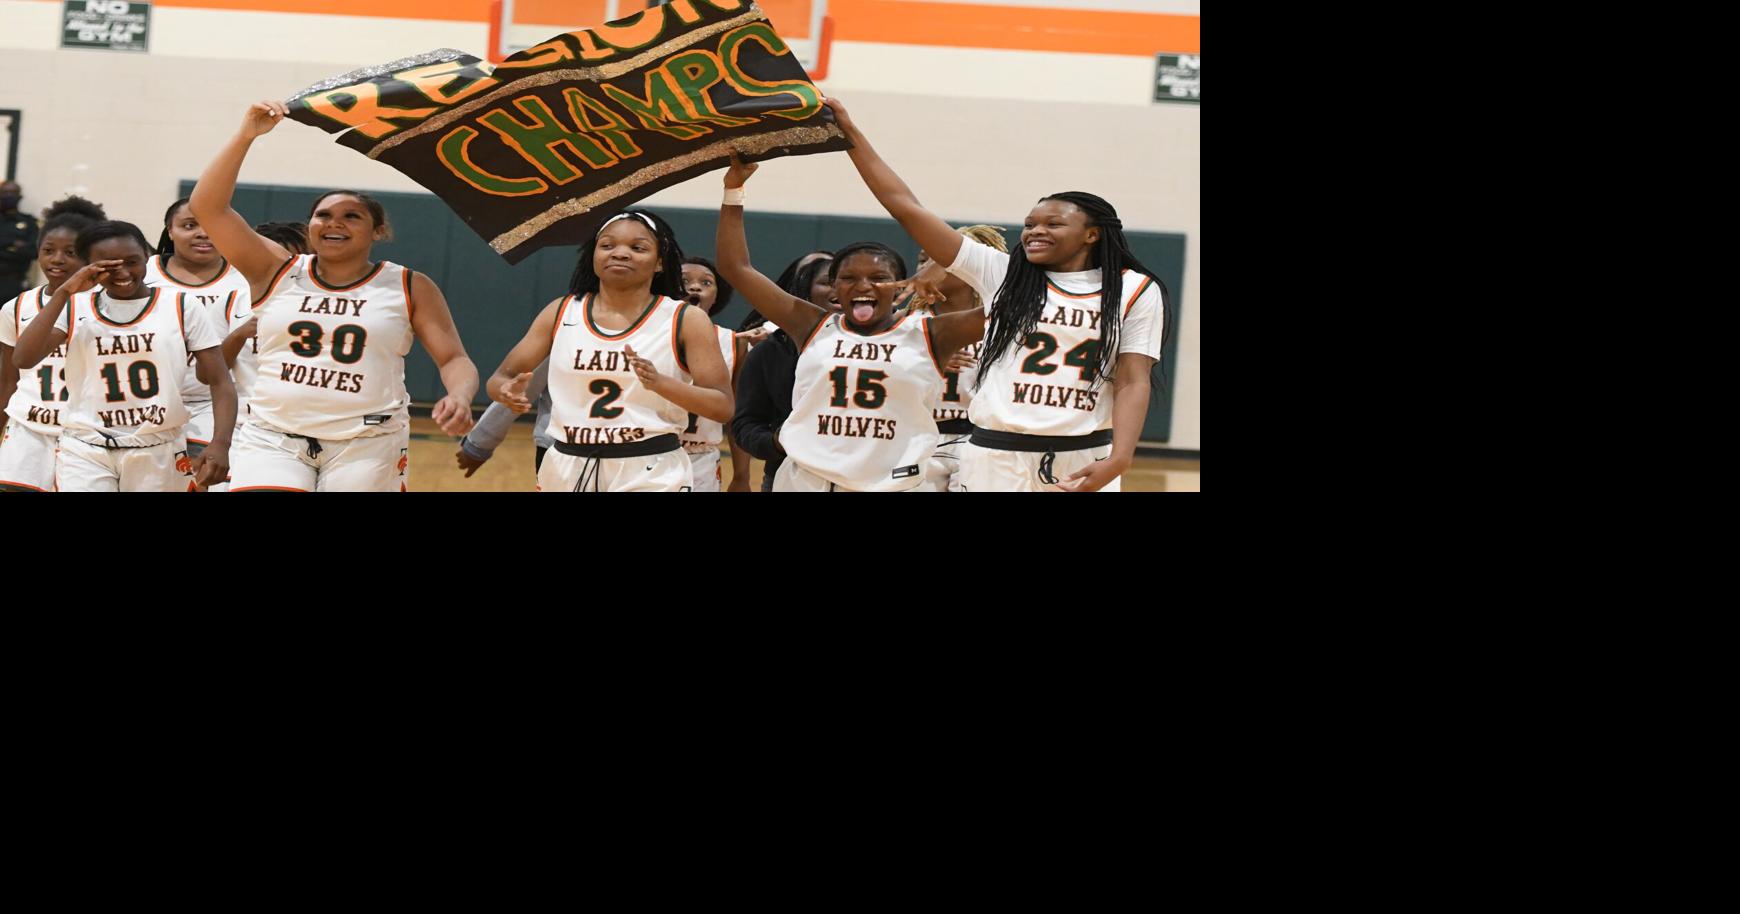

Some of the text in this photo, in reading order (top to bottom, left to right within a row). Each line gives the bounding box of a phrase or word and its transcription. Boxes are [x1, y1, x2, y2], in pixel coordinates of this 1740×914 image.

[86, 0, 129, 14] NO
[436, 22, 825, 197] CHAMPS
[299, 296, 367, 317] LADY
[95, 333, 156, 356] LADY
[287, 320, 368, 364] 30
[833, 340, 897, 362] LADY
[1020, 332, 1105, 382] 24
[574, 349, 637, 372] LADY
[100, 360, 160, 403] 10
[280, 362, 364, 394] WOLVES
[829, 365, 889, 409] 15
[588, 379, 625, 420] 2
[1012, 382, 1099, 412] WOLVES
[27, 405, 61, 426] WOL
[817, 414, 896, 440] WOLVES
